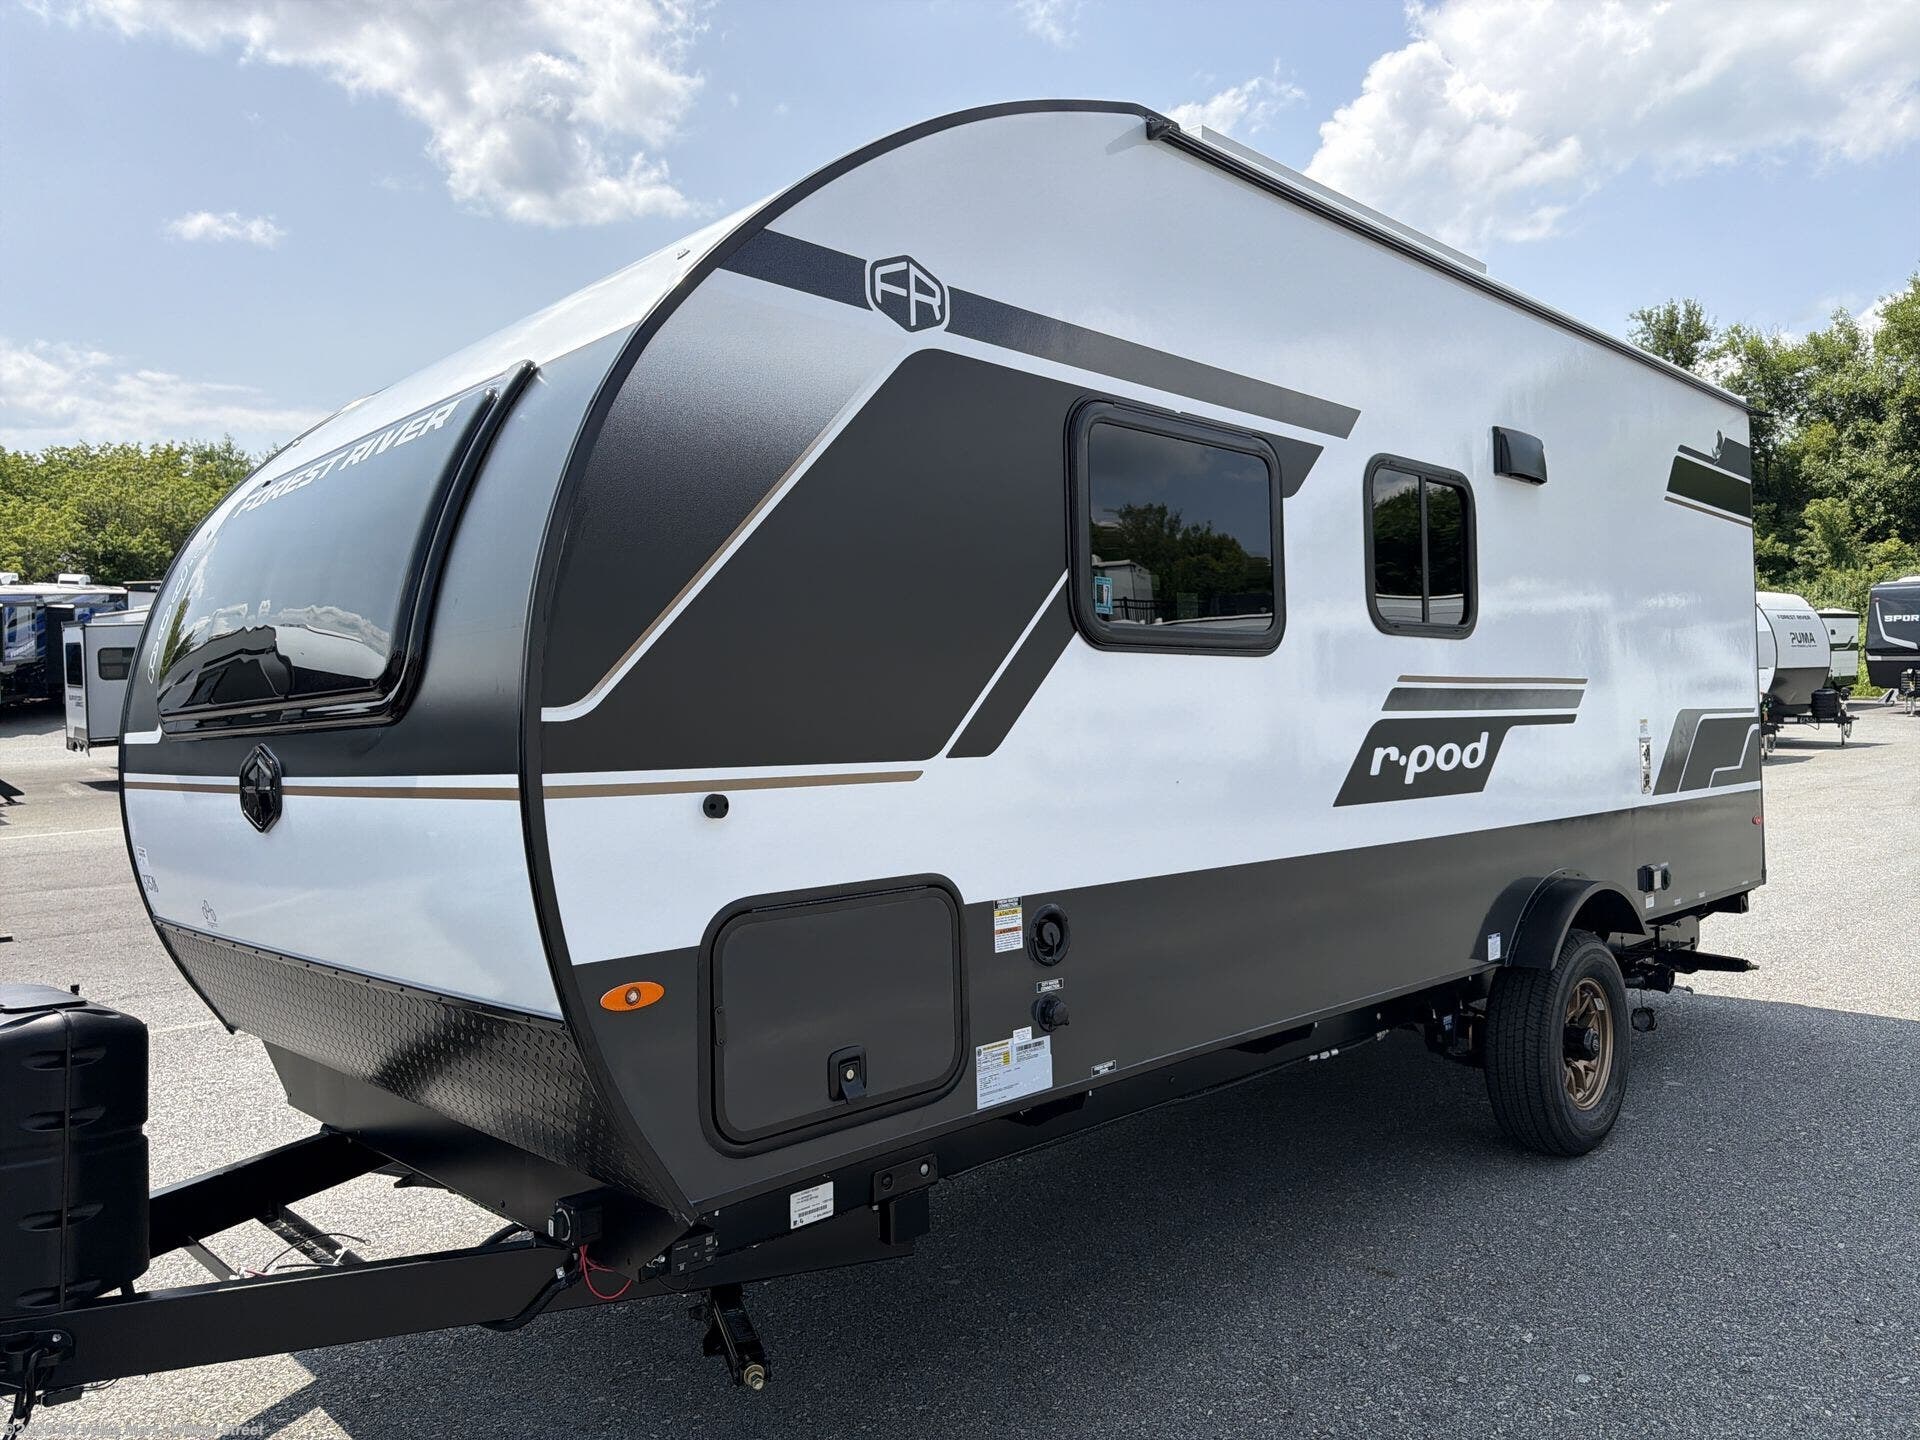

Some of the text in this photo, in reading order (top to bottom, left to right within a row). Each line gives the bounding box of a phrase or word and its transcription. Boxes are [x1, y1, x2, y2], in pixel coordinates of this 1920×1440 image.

[875, 261, 941, 327] FR
[233, 400, 462, 519] FOREST RIVER
[1790, 632, 1816, 644] PUMA
